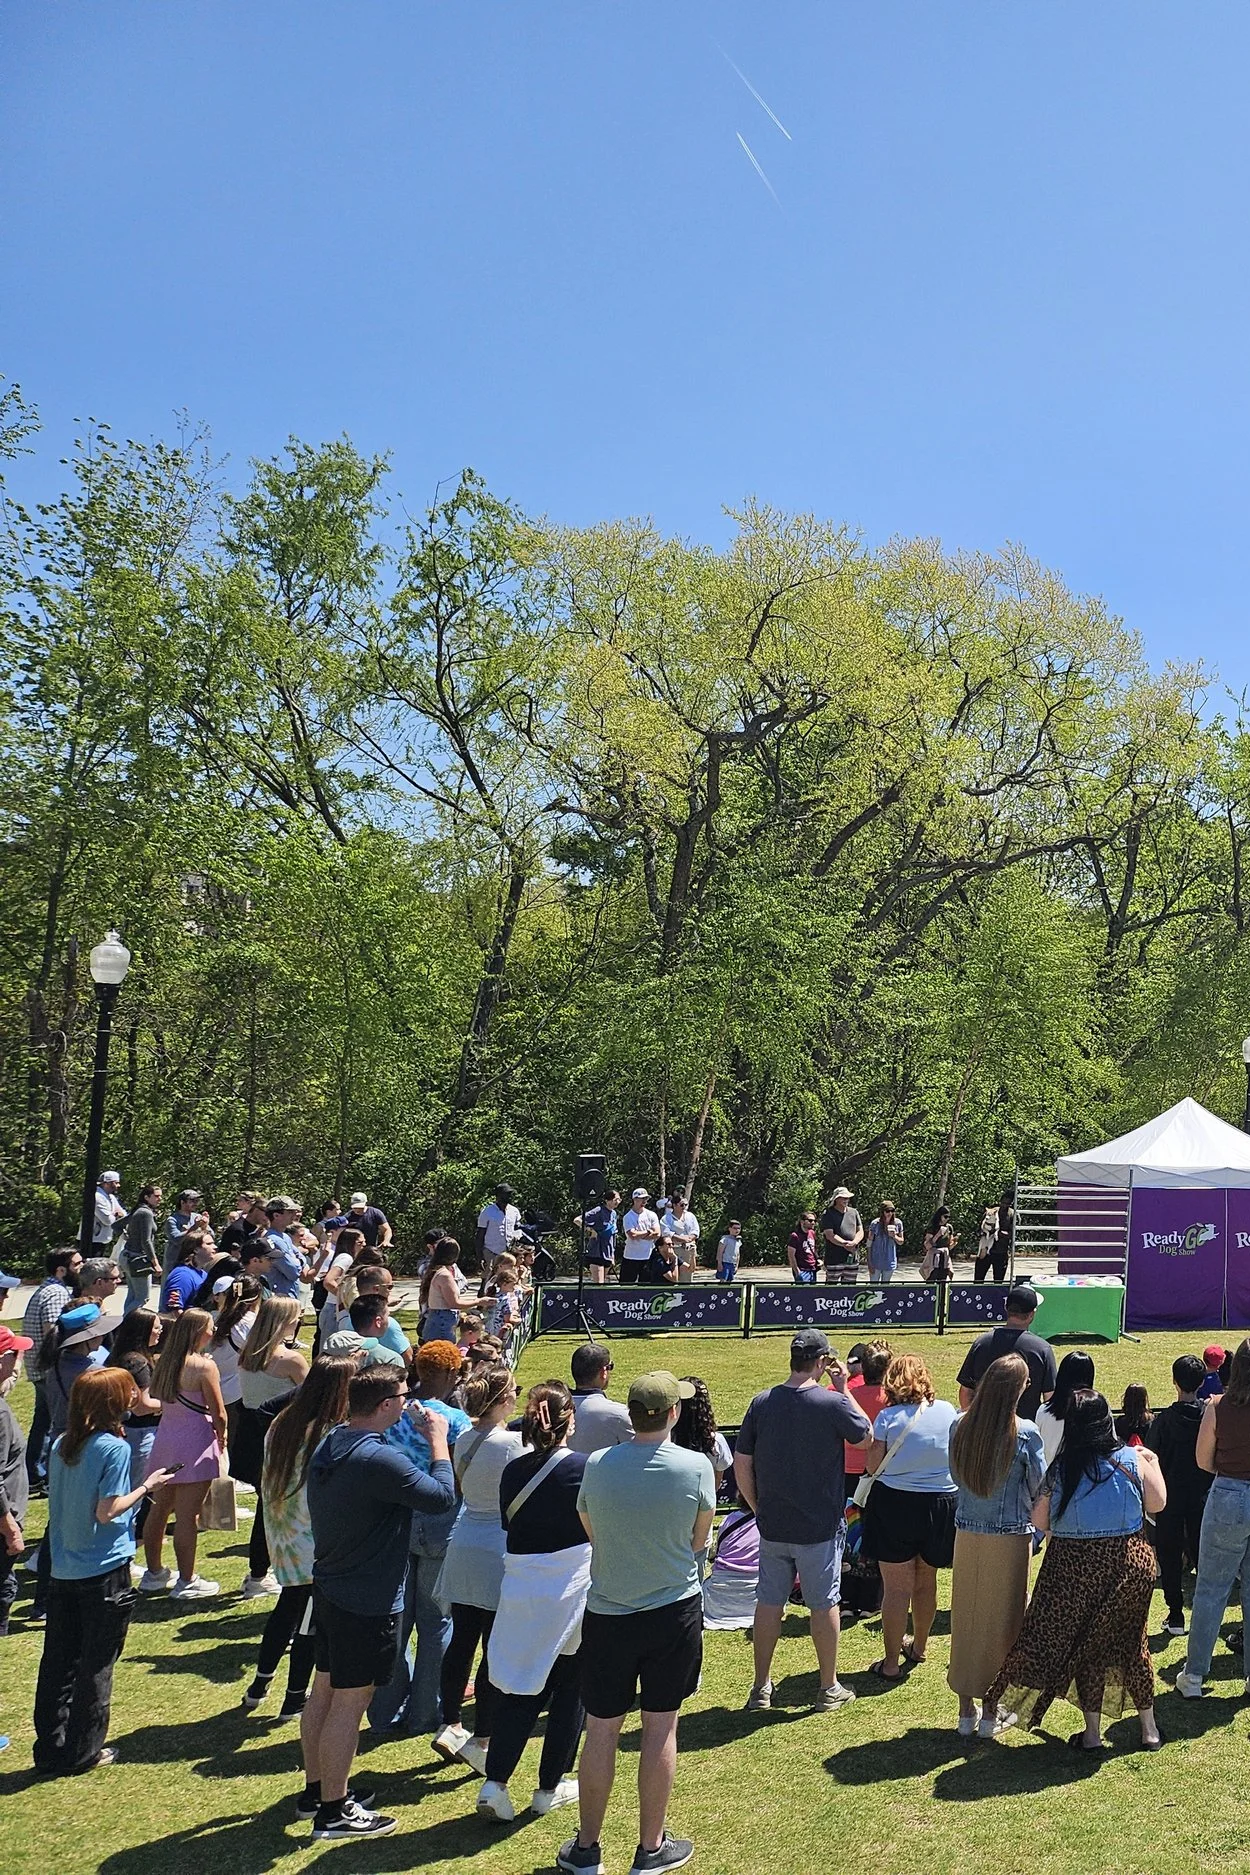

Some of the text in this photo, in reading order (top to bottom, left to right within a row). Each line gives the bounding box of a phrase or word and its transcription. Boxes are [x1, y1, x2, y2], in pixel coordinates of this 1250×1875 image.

[1159, 1244, 1196, 1256] Dog Show
[624, 1310, 643, 1320] Dog
[830, 1307, 848, 1317] Dog
